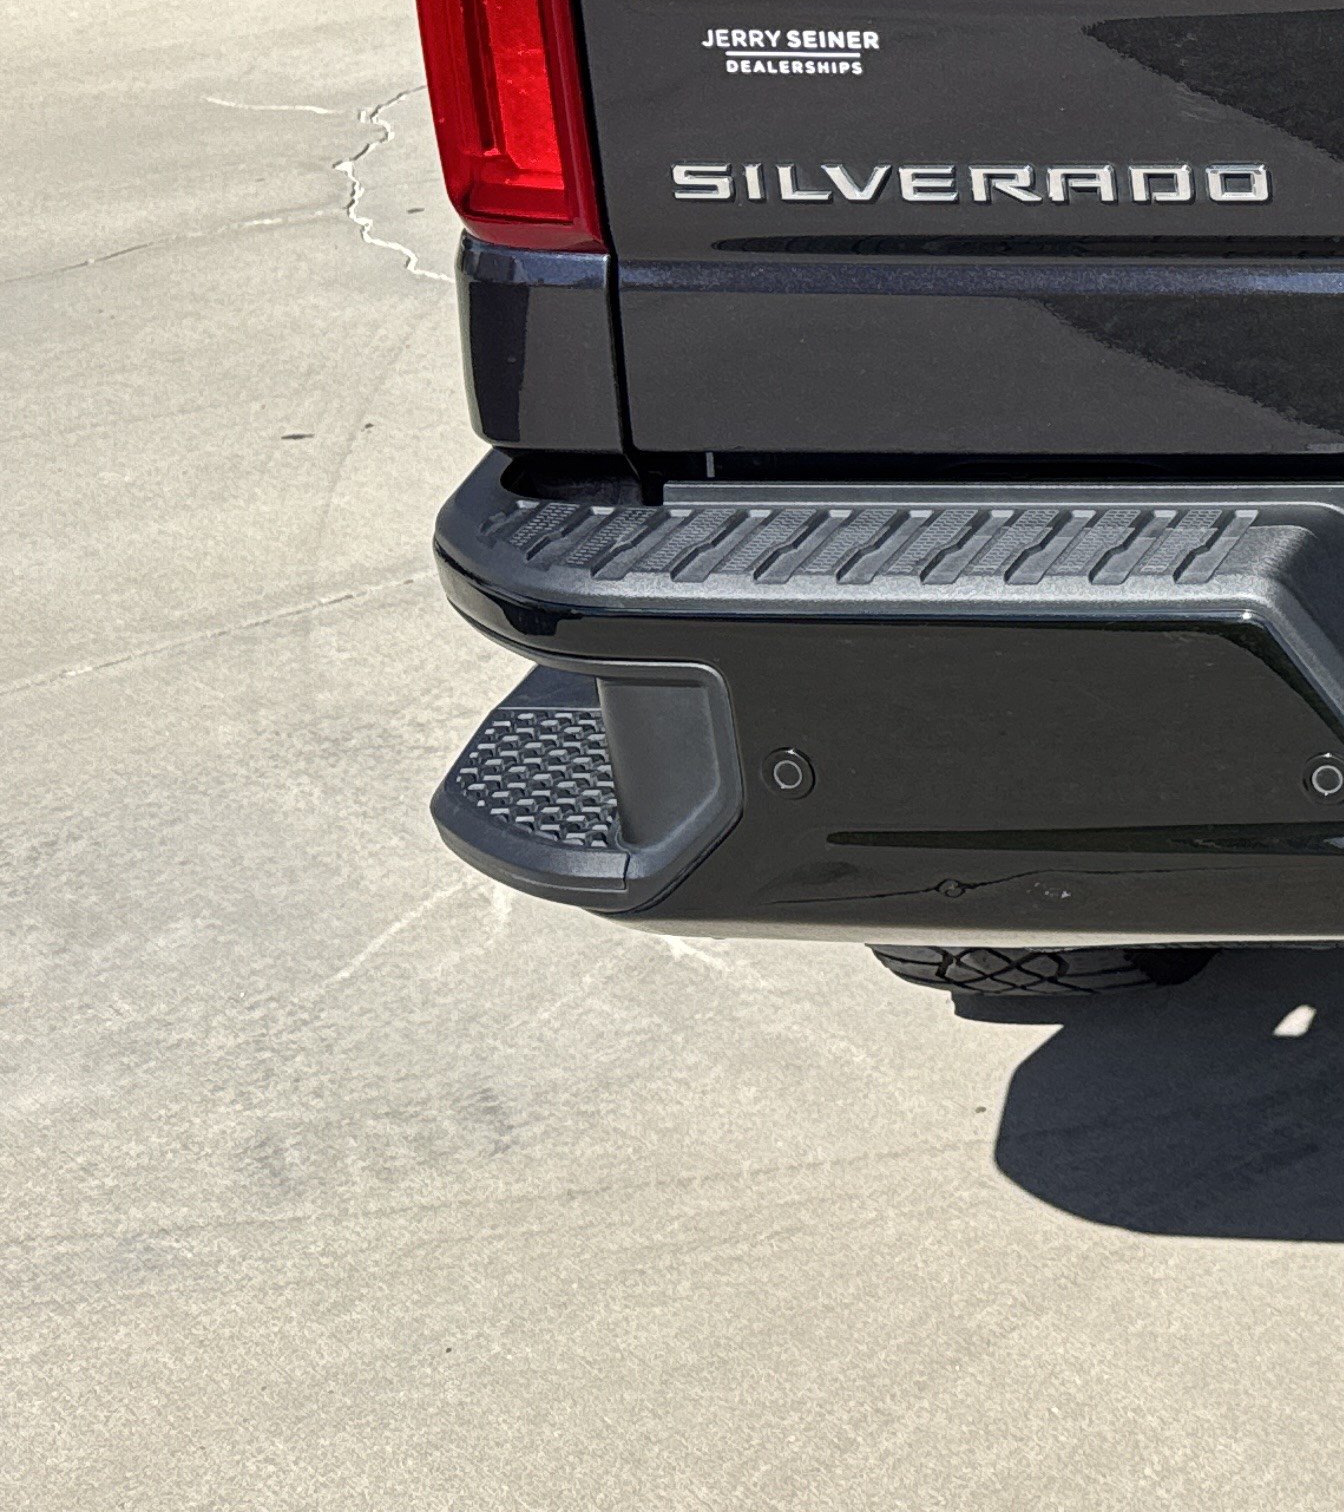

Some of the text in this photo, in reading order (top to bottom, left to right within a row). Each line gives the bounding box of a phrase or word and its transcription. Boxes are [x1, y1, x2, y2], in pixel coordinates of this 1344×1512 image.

[701, 29, 880, 49] JERRY SEINER
[725, 60, 863, 75] DEALERSHIPS
[671, 162, 1273, 204] SILVERADO
